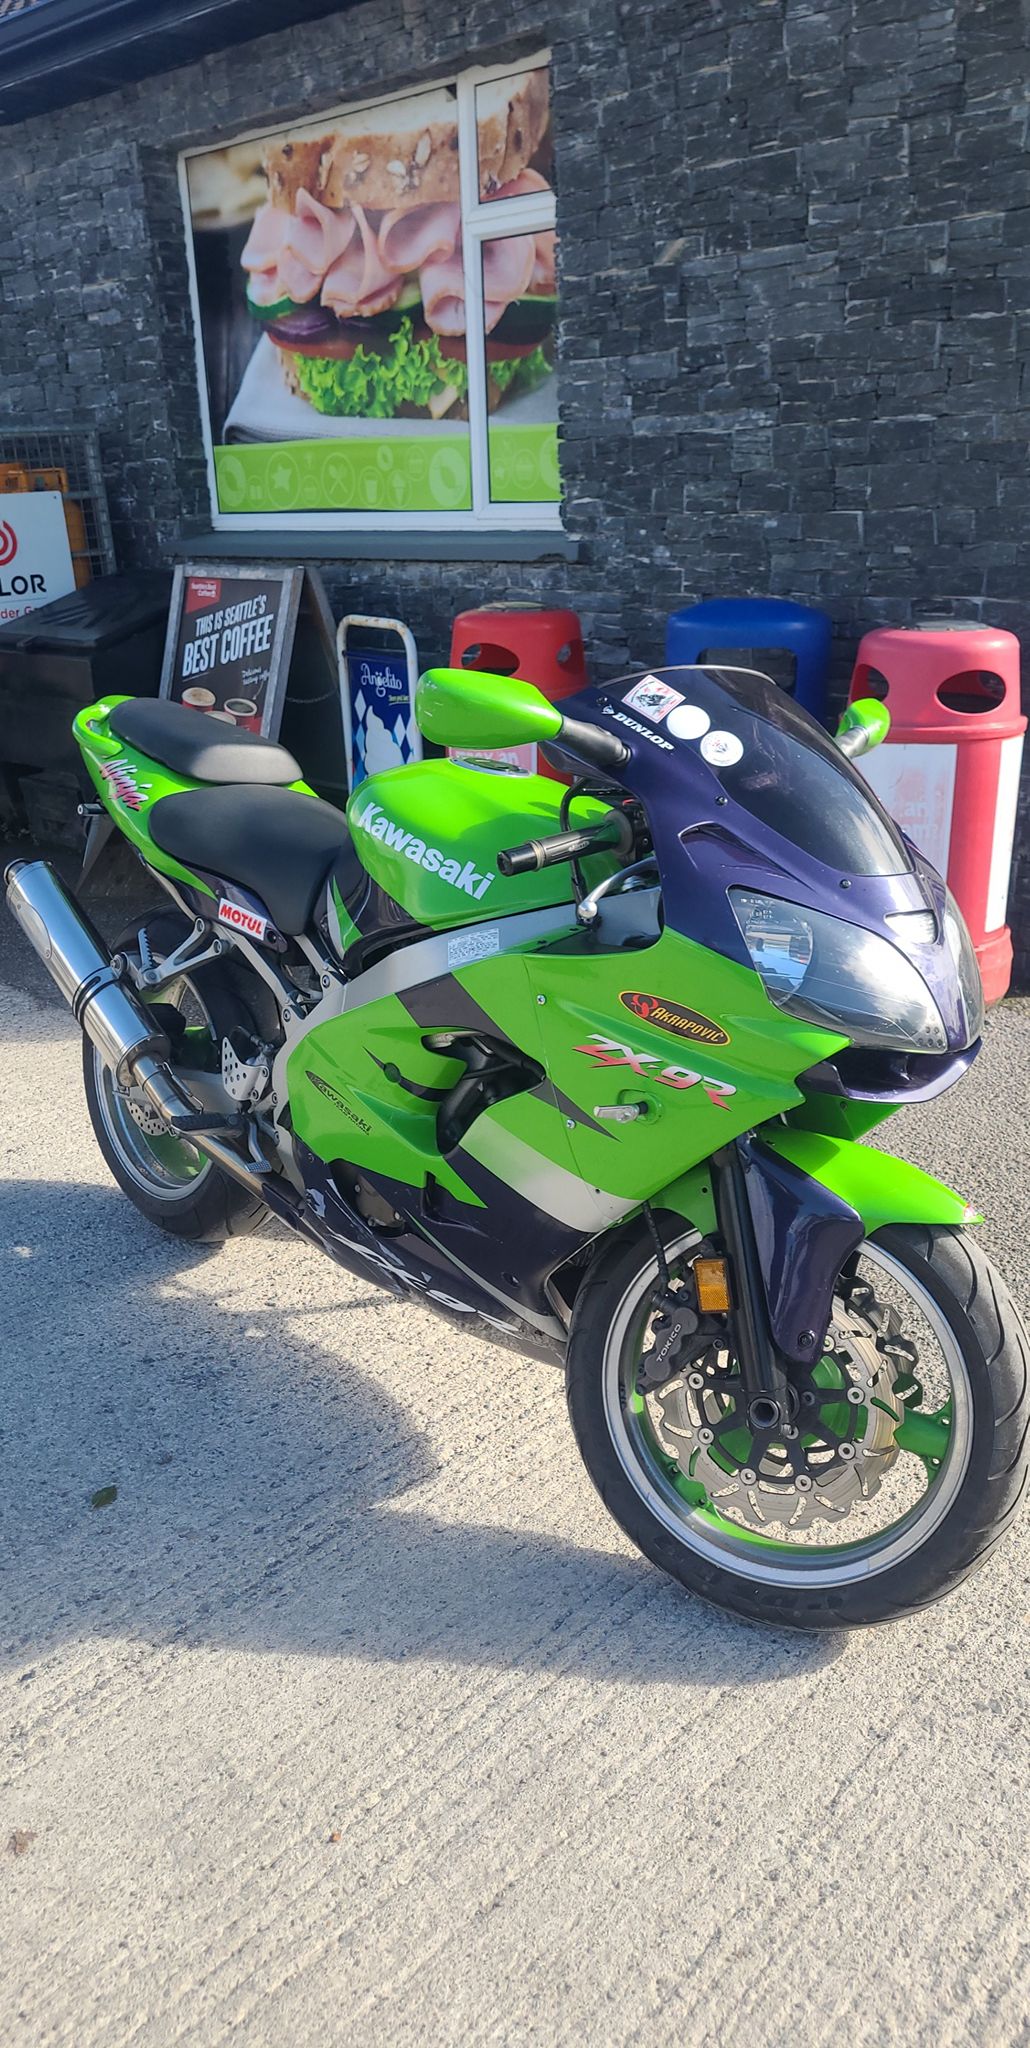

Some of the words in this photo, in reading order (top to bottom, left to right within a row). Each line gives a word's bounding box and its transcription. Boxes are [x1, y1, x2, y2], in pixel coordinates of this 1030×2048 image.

[195, 613, 214, 637] THIS
[214, 610, 224, 631] IS
[223, 594, 267, 627] SEATTLE'S
[182, 633, 220, 677] BEST
[220, 614, 274, 665] COFFEE
[612, 711, 675, 751] DUNLOP
[100, 759, 153, 811] Ninja
[357, 801, 496, 900] Kawasaki
[219, 903, 263, 936] MOTUL
[572, 1033, 738, 1112] ZX-9R
[656, 1323, 682, 1362] TOKICO
